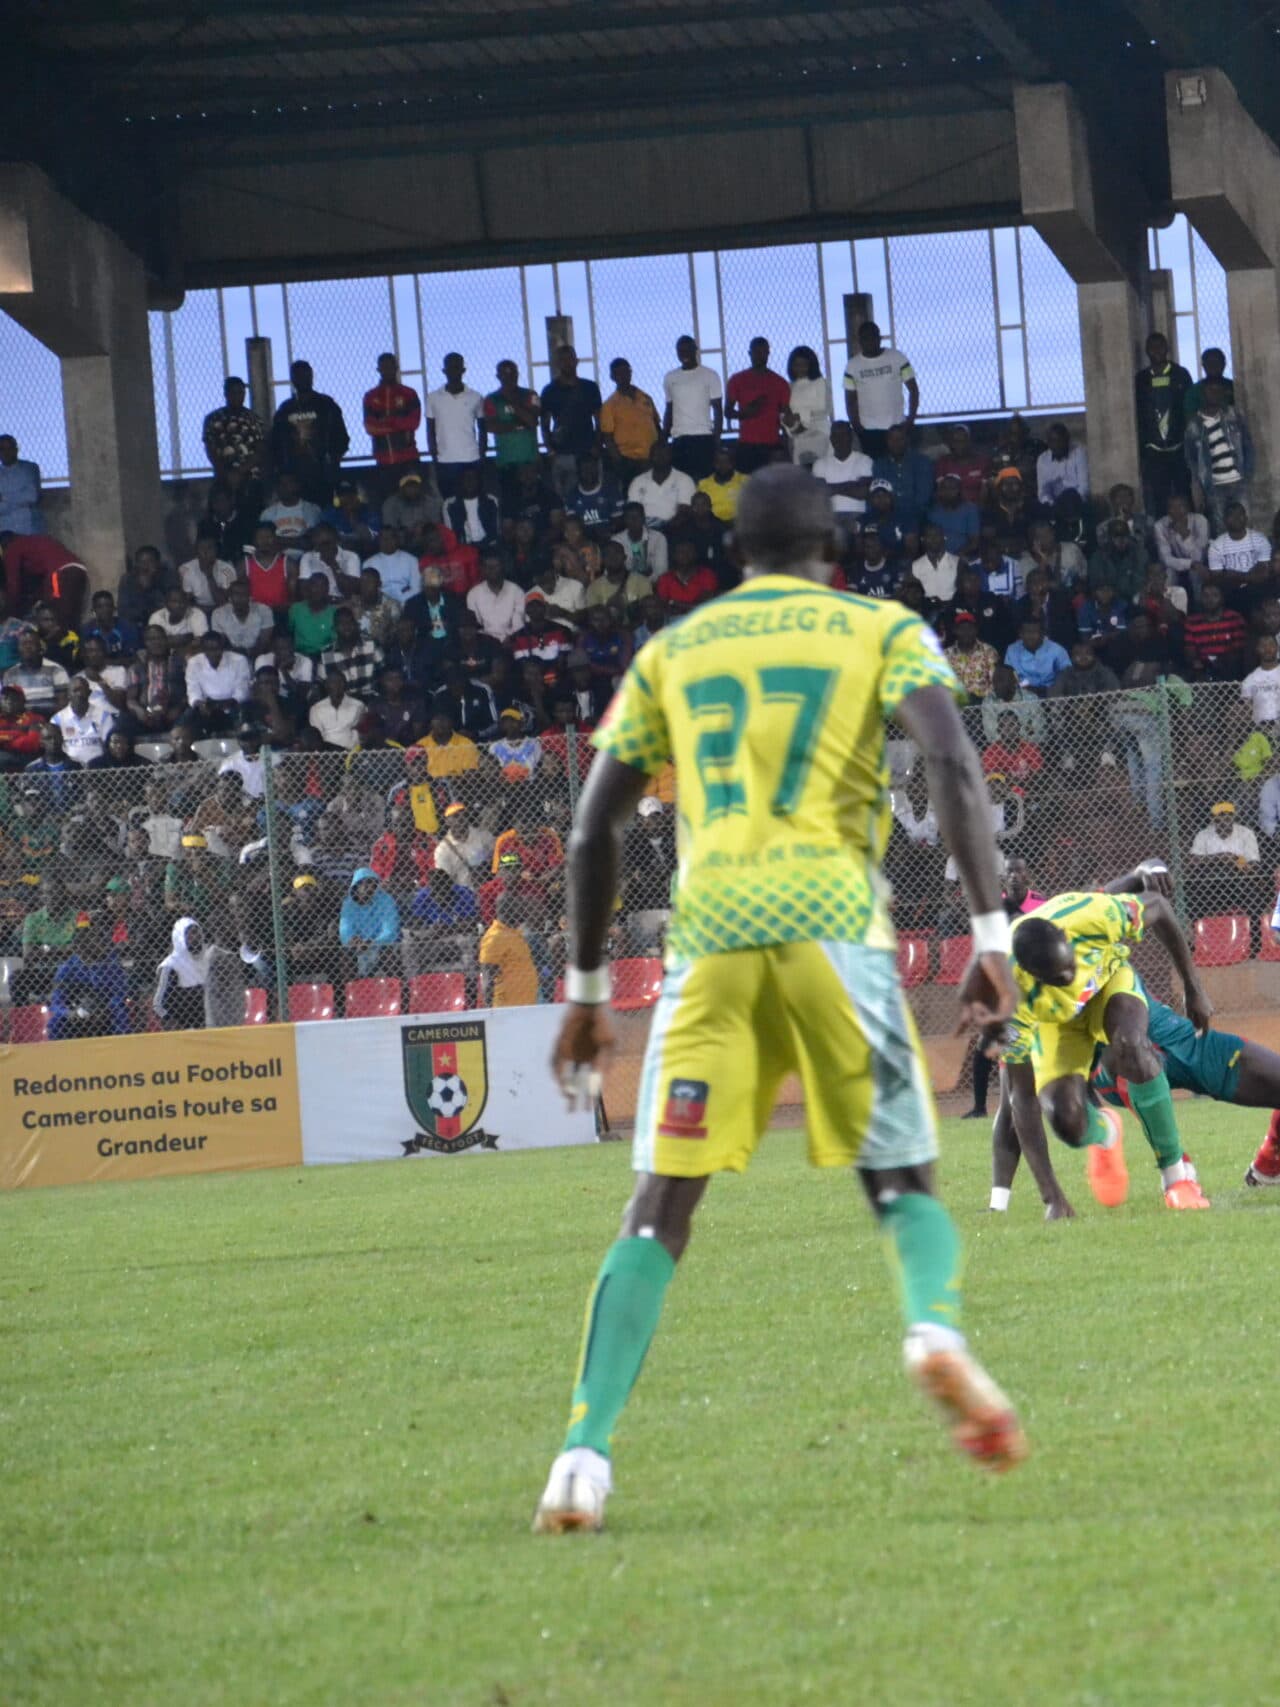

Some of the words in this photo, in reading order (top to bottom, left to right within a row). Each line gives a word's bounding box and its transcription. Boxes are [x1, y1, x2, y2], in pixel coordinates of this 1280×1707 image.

[682, 666, 839, 826] 27
[408, 1025, 479, 1040] CAMEROUN
[13, 1074, 146, 1096] Redonnons
[151, 1069, 180, 1086] au
[186, 1058, 282, 1083] Football
[22, 1100, 177, 1129] Camerounais
[183, 1096, 244, 1117] toute
[250, 1096, 277, 1112] sa
[97, 1133, 208, 1157] Grandeur
